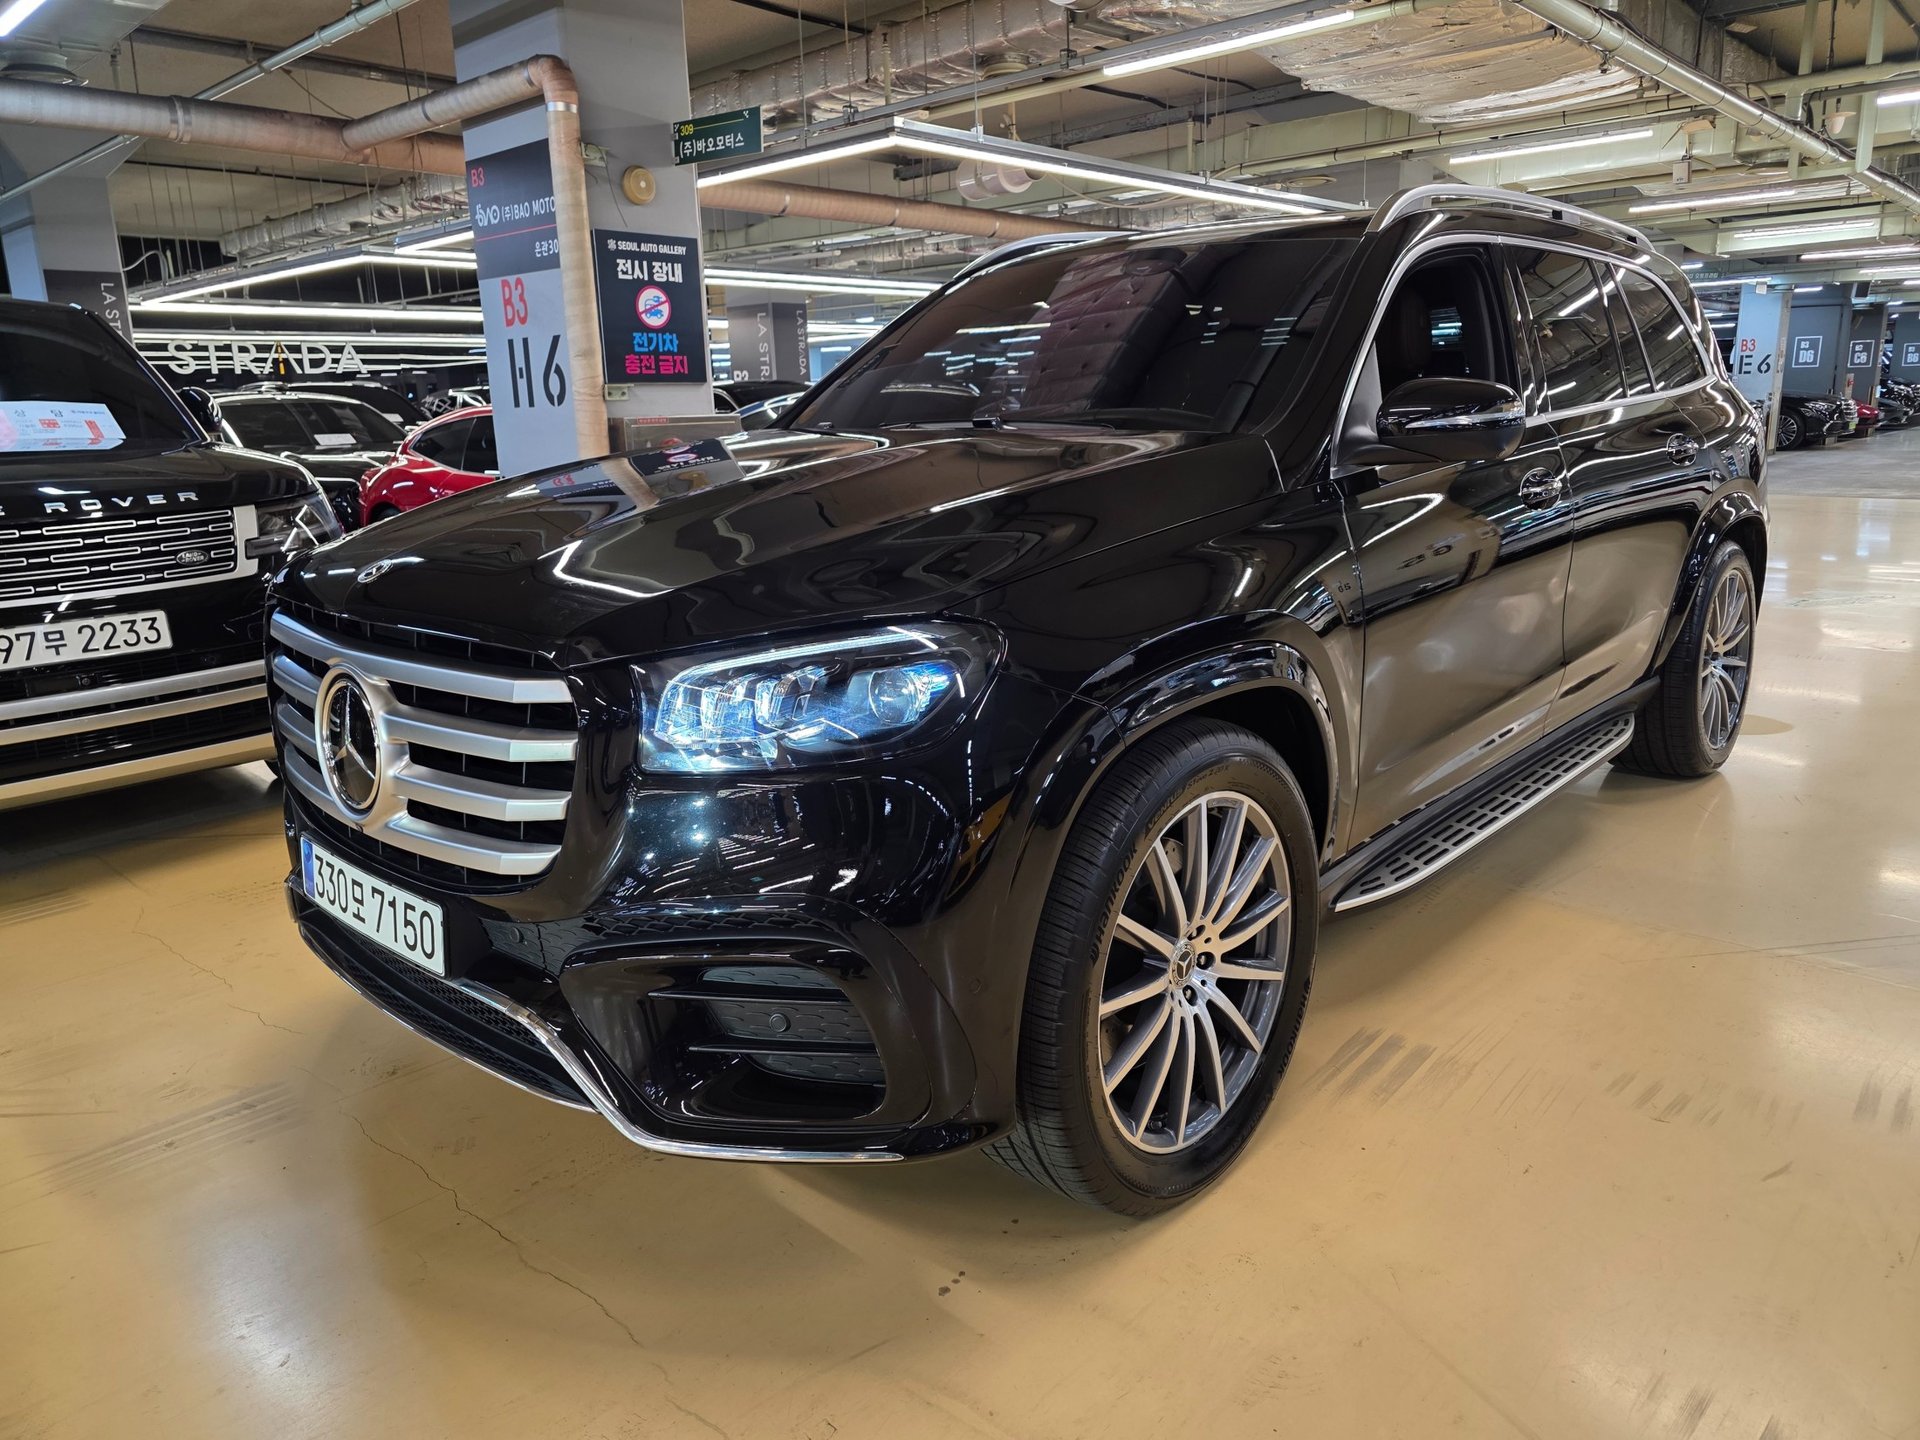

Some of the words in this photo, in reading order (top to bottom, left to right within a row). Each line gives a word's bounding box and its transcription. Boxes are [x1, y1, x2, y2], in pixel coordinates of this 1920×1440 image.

[680, 124, 694, 136] 309
[680, 132, 744, 158] (주)바오모터스
[471, 168, 484, 187] B3
[617, 240, 639, 252] SEOUL
[640, 243, 658, 254] AUTO
[658, 245, 686, 256] GALLERY
[616, 258, 649, 281] 전시
[651, 261, 683, 283] 장내
[101, 283, 116, 304] LA
[501, 276, 528, 327] B3
[105, 308, 123, 336] ST
[757, 312, 767, 337] LA
[632, 331, 678, 352] 전기차
[797, 328, 807, 376] STRADA
[1741, 339, 1756, 352] B3
[167, 340, 368, 375] STRADA
[625, 354, 656, 374] 충전
[658, 355, 688, 374] 금지
[759, 342, 770, 381] STR
[1798, 350, 1814, 363] D6
[1853, 352, 1867, 364] C6
[44, 491, 199, 514] ROVER
[77, 616, 162, 654] 2233
[371, 886, 435, 960] 7150
